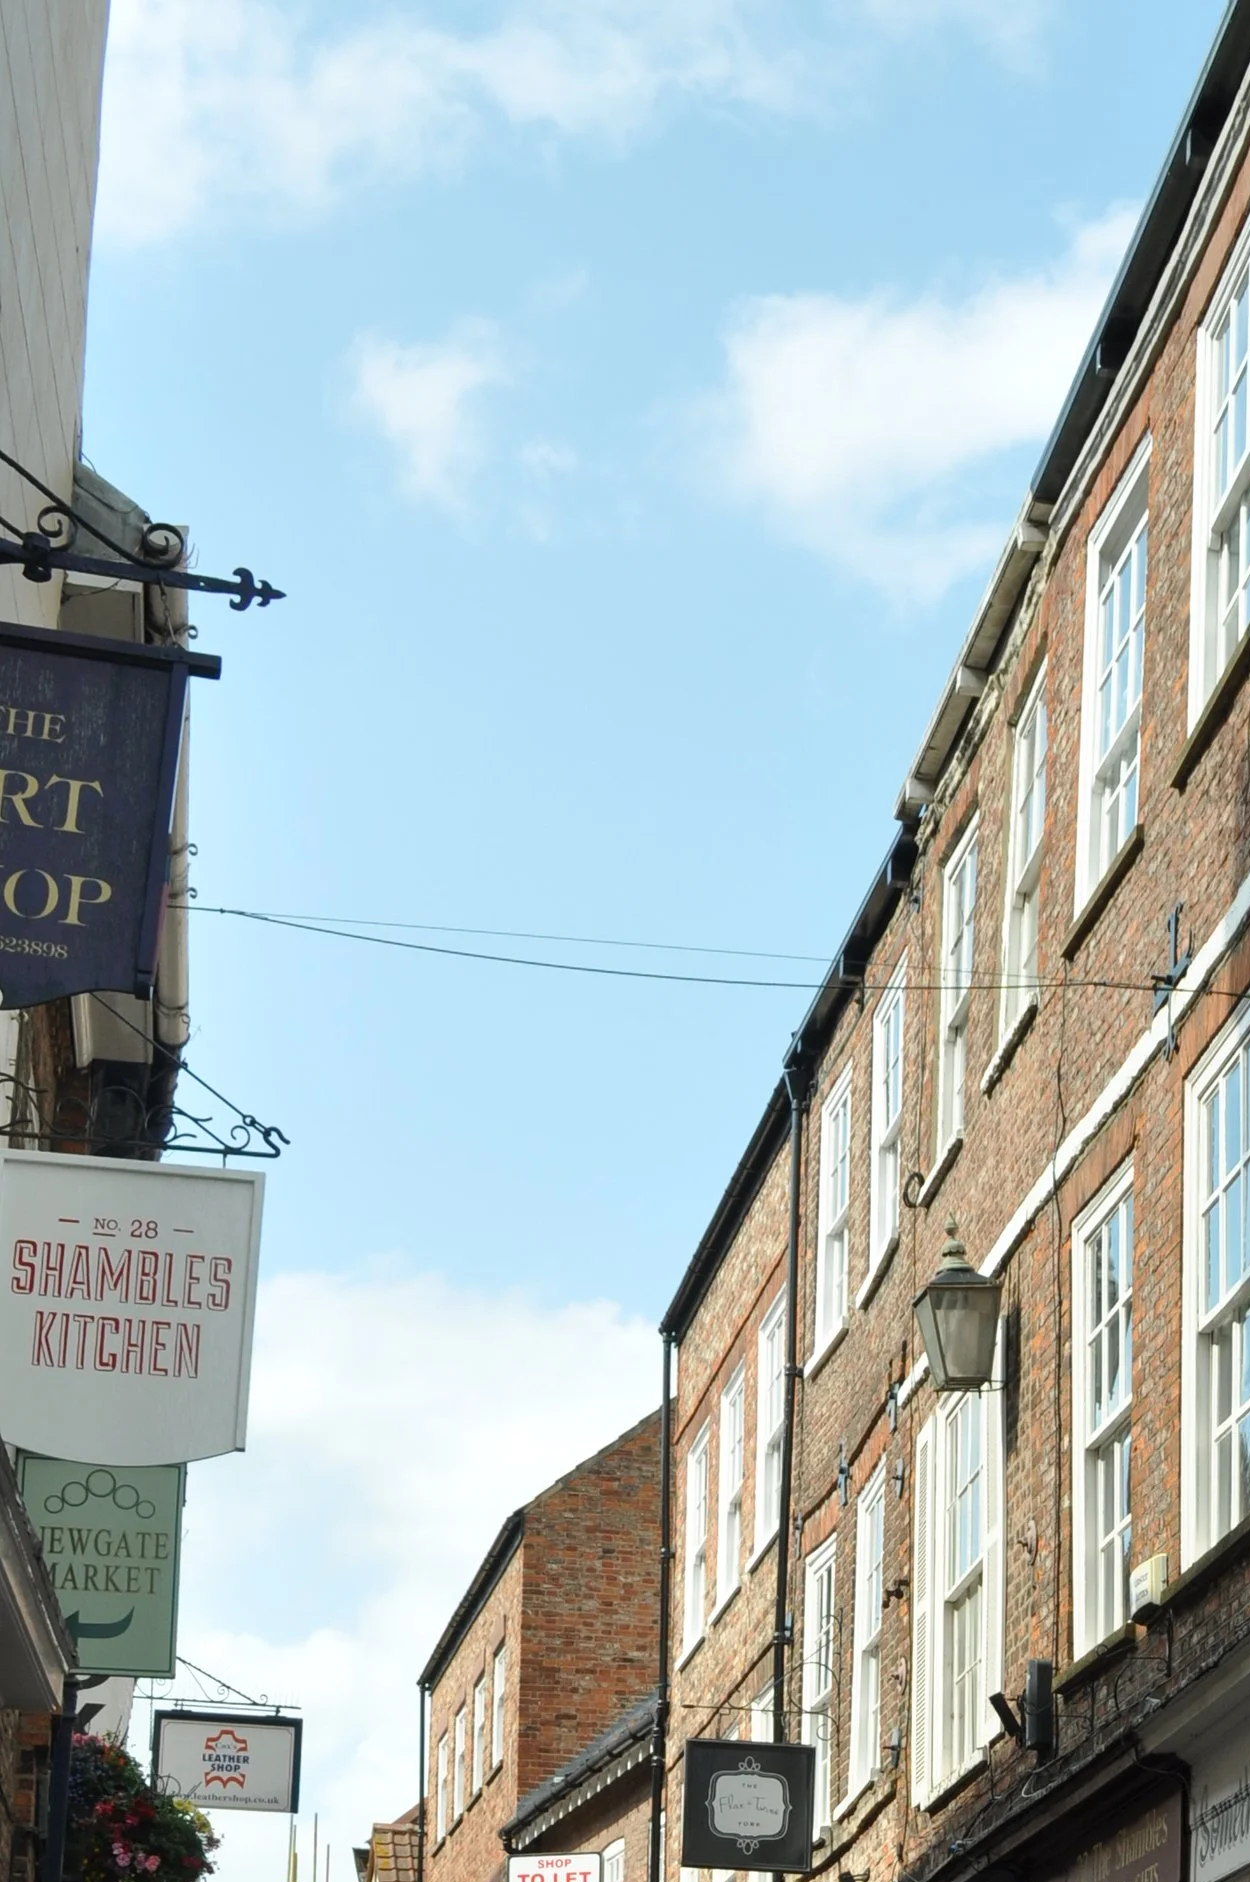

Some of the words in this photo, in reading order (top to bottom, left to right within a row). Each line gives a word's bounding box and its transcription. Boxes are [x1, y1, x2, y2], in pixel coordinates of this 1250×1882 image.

[0, 706, 66, 743] HE
[0, 865, 112, 926] OP
[130, 1220, 159, 1239] 28
[11, 1239, 233, 1312] SHAMBLES
[32, 1310, 201, 1378] KITCHEN
[202, 1753, 250, 1765] LEATHER
[211, 1763, 241, 1773] SHOP
[1115, 1808, 1169, 1870] Shambles
[538, 1858, 572, 1869] SHOP
